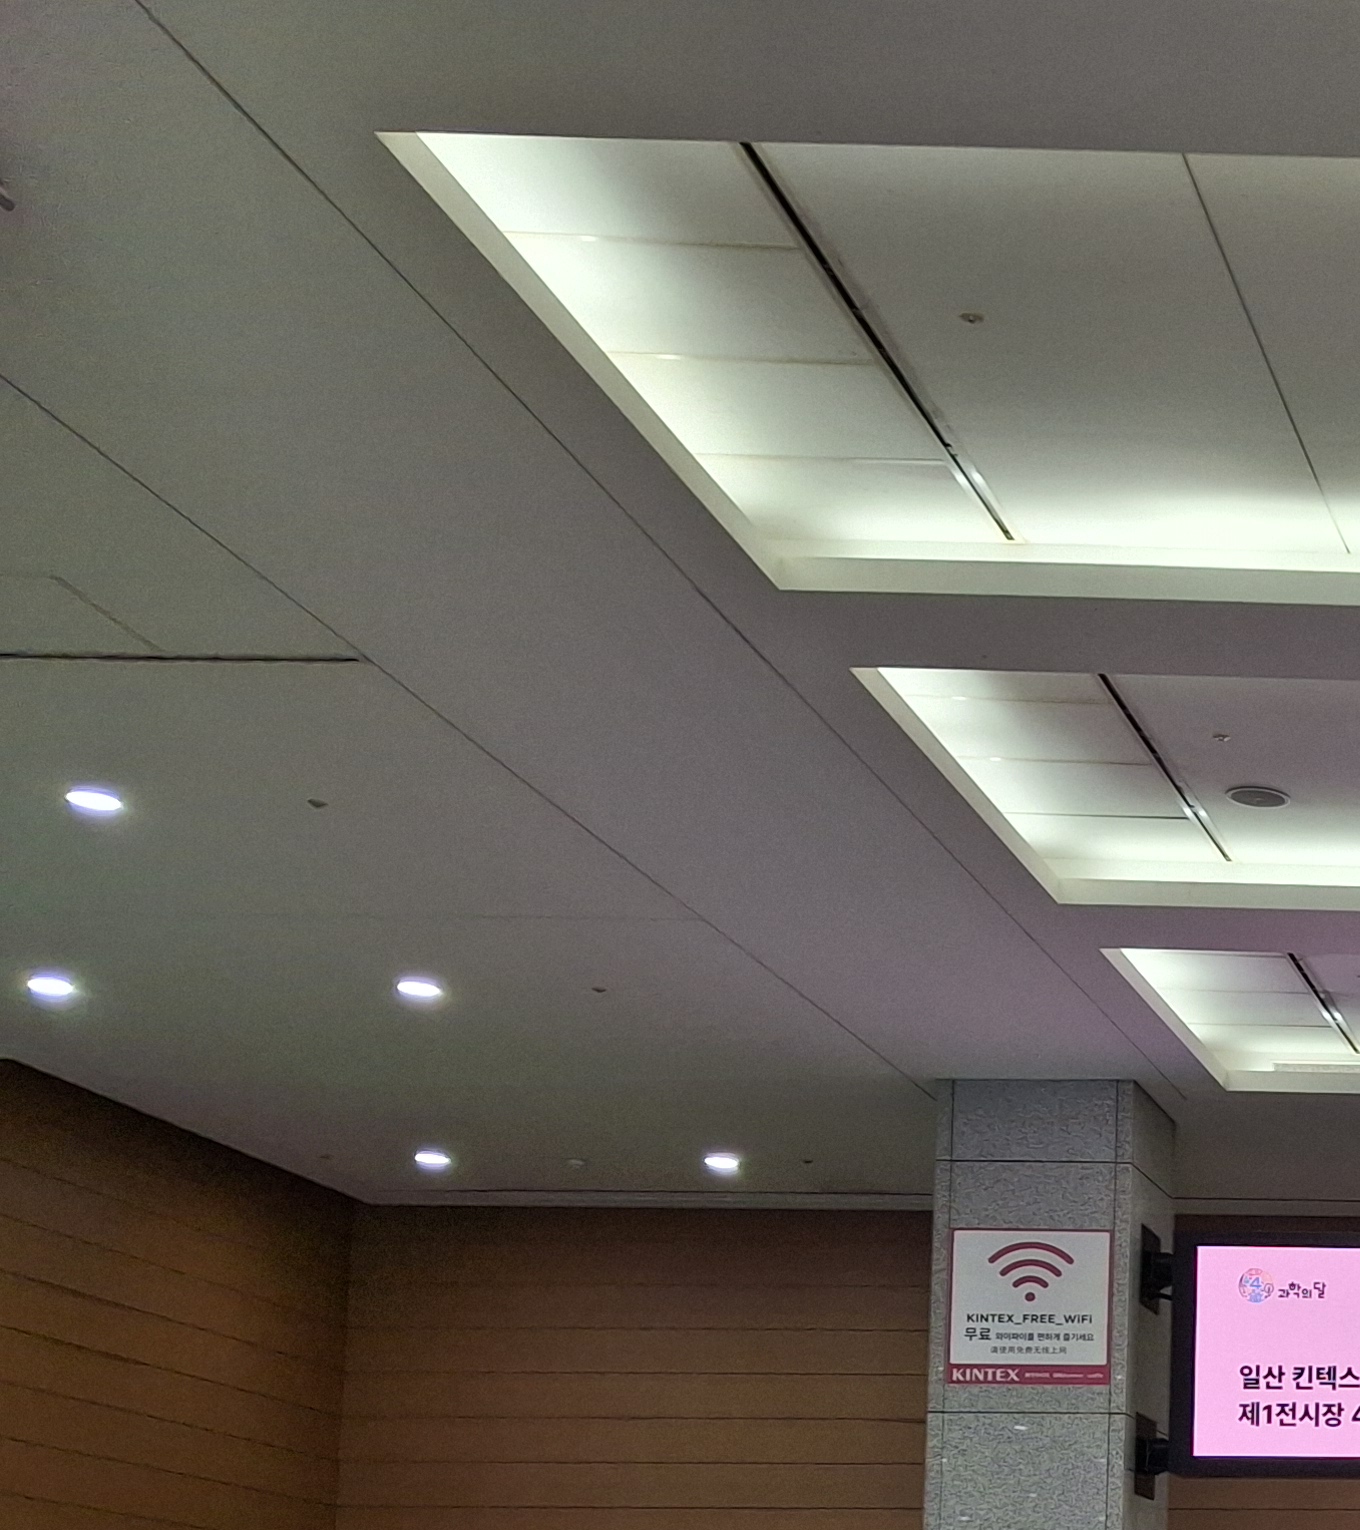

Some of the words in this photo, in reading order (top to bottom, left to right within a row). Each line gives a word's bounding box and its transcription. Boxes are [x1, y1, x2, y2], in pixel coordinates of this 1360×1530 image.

[966, 1313, 1094, 1326] KINTEX_FREE_WiFi
[964, 1327, 992, 1341] 무료
[952, 1368, 1021, 1382] KINTEX
[1239, 1365, 1286, 1390] 일산
[1238, 1402, 1345, 1428] 제1전시장
